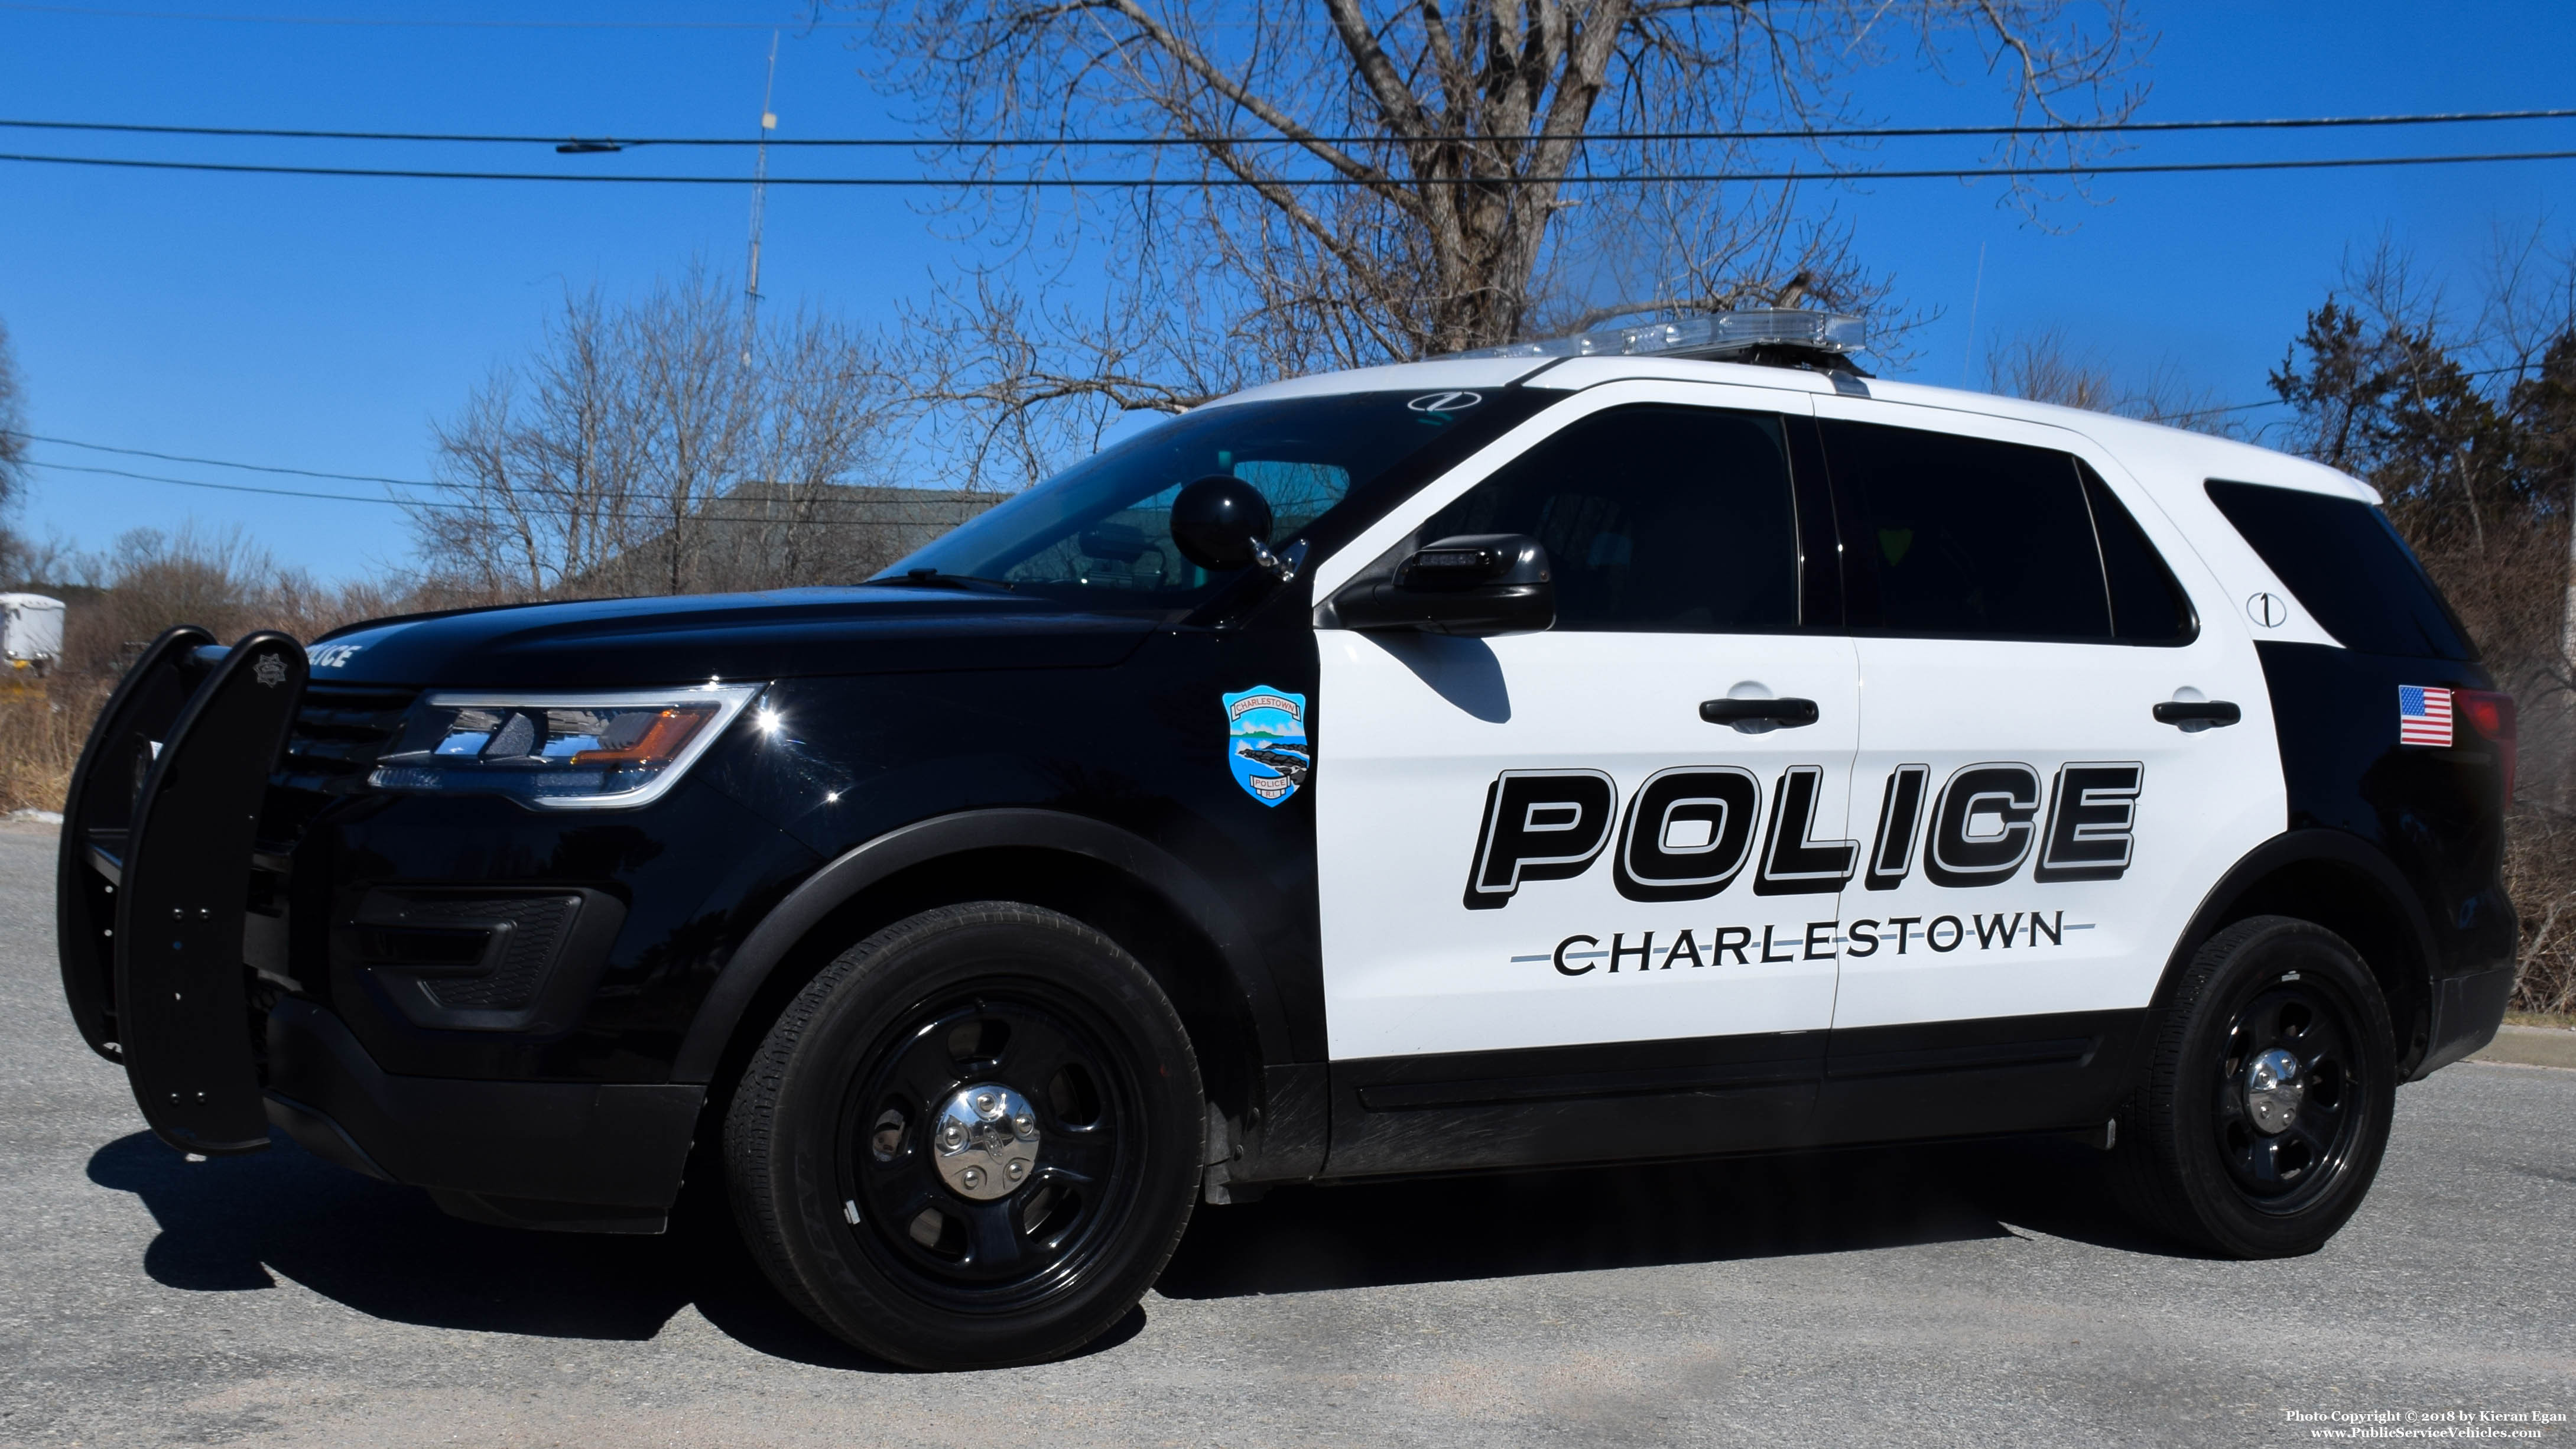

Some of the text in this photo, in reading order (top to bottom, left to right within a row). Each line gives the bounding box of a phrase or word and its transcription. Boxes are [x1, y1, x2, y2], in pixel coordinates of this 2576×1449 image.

[2260, 592, 2272, 629] 1
[305, 645, 363, 667] LICE
[1236, 697, 1295, 712] CHARLESTOWN
[1255, 779, 1286, 788] POLICE
[1463, 760, 2145, 911] POLICE
[1552, 910, 2065, 977] CHARLESTOWN
